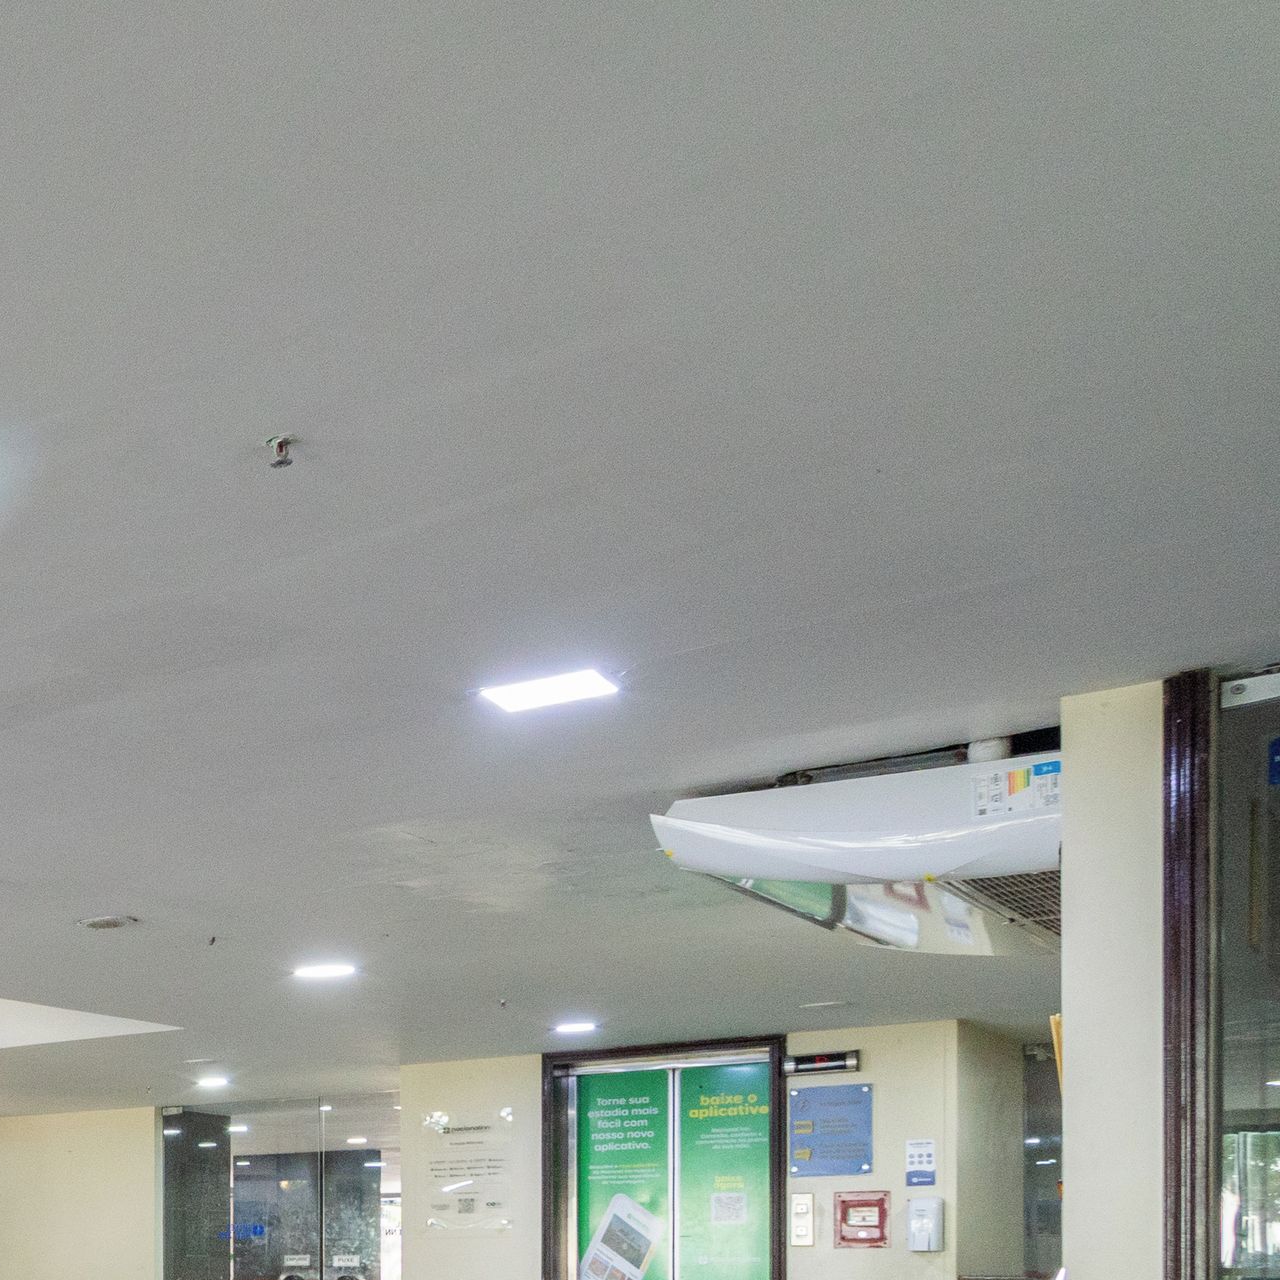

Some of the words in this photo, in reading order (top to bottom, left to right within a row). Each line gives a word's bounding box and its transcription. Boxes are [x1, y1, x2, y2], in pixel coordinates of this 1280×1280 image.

[596, 1097, 626, 1106] Torne
[628, 1096, 650, 1105] sua
[699, 1093, 744, 1106] baixe
[747, 1094, 757, 1103] o
[587, 1107, 629, 1118] estadia
[631, 1106, 659, 1116] mais
[689, 1104, 769, 1119] aplicativo
[597, 1118, 621, 1128] fácil
[623, 1119, 648, 1128] com
[591, 1130, 624, 1140] nosso
[627, 1130, 655, 1139] novo
[594, 1140, 651, 1152] aplicativo.
